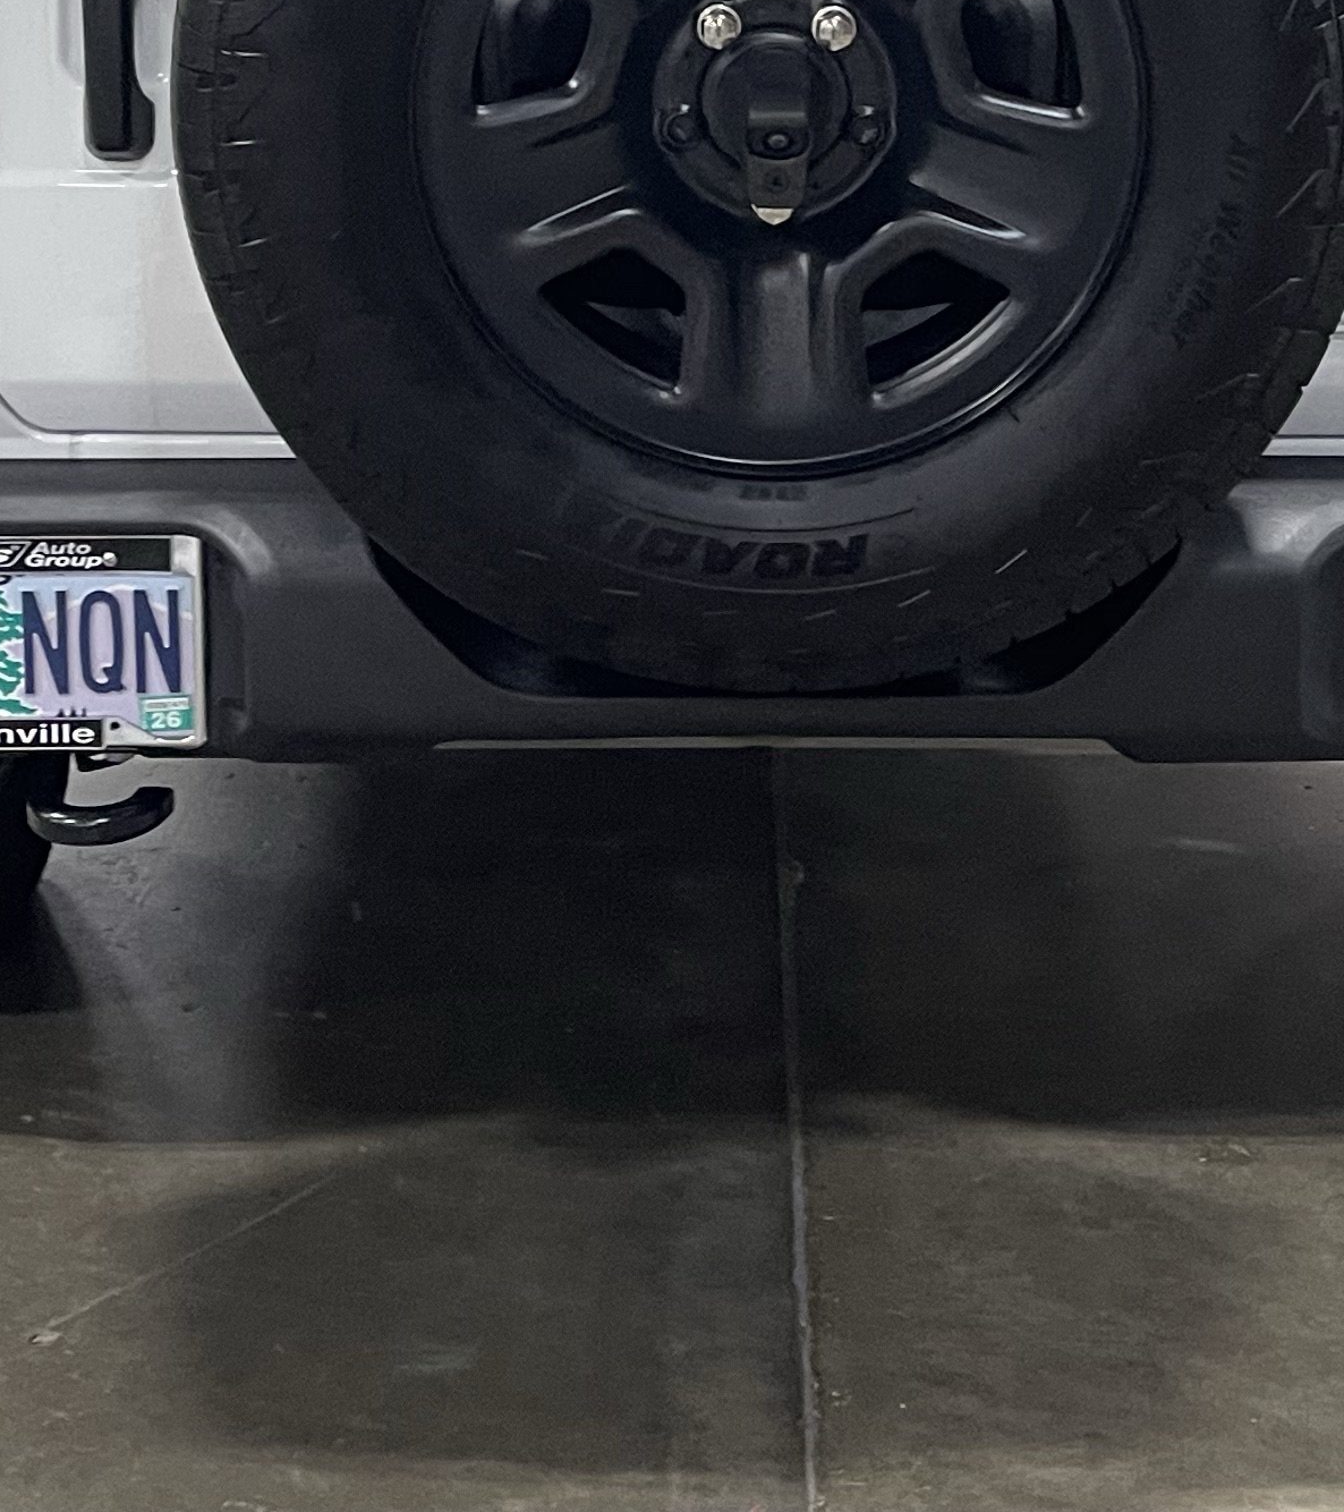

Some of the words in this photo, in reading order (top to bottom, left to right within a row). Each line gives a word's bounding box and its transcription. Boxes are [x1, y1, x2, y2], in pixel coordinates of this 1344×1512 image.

[30, 541, 92, 556] Auto
[24, 553, 103, 570] Group
[22, 589, 183, 697] NQN
[151, 710, 182, 730] 26
